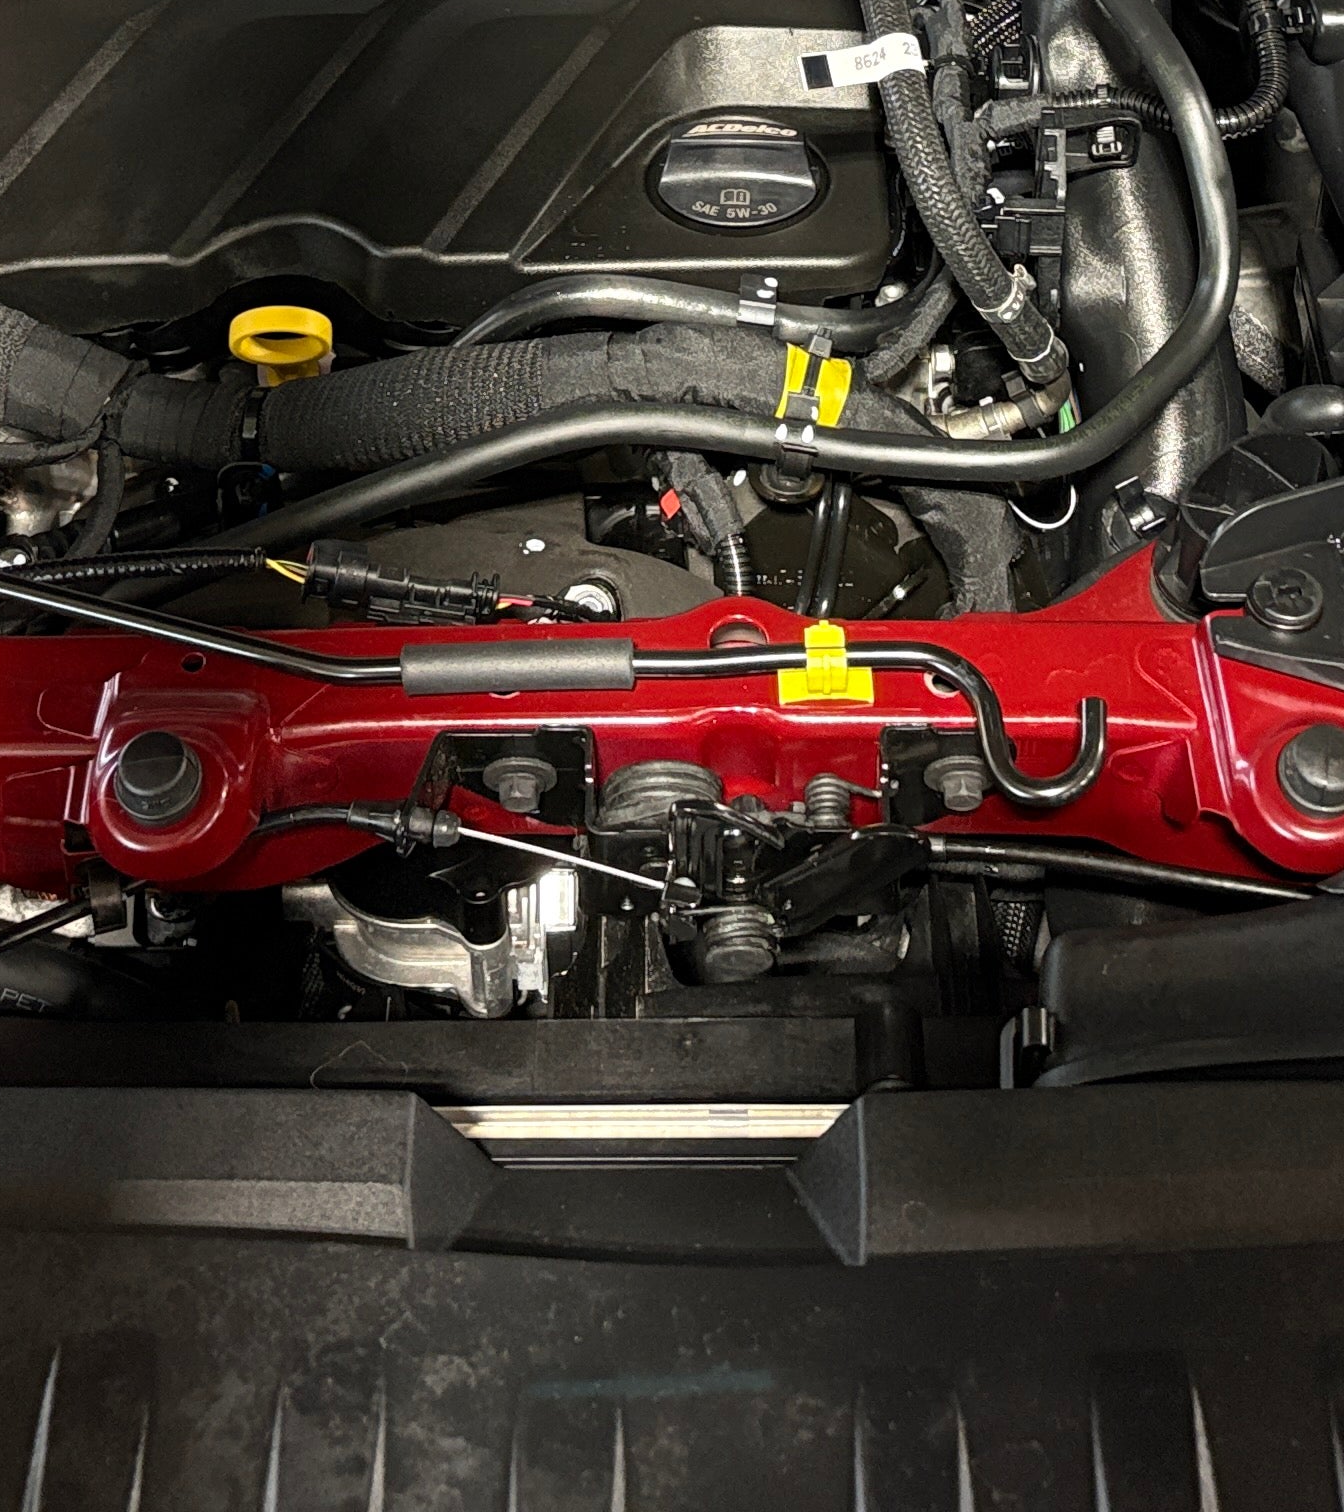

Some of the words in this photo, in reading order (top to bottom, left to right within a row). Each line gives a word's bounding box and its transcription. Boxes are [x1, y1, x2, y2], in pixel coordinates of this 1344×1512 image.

[854, 46, 886, 70] 8624
[686, 123, 798, 137] ACDelco
[691, 200, 720, 217] SAE
[726, 202, 778, 219] 5W-30
[0, 987, 54, 1014] PET
